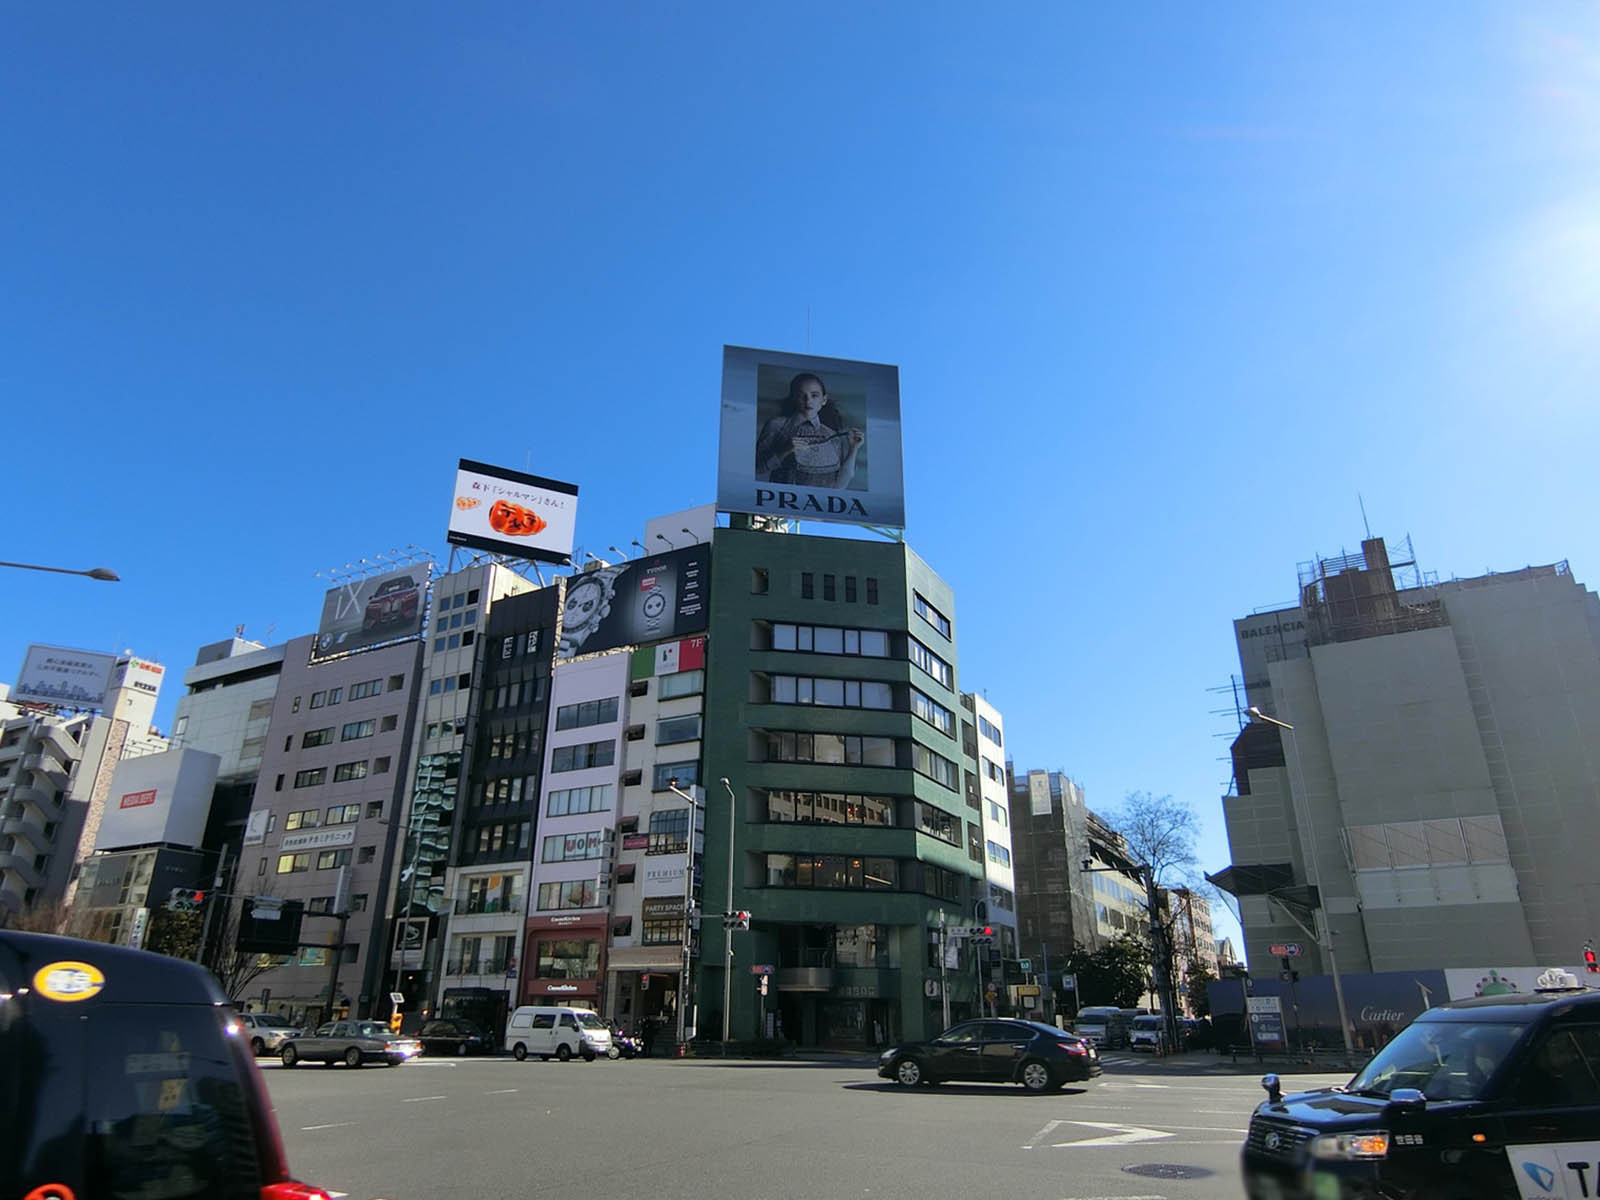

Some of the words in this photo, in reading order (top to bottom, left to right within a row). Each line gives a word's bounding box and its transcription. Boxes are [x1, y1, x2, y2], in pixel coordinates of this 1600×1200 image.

[755, 488, 868, 516] PRADA
[691, 639, 703, 648] 7F
[1361, 1005, 1404, 1022] Cartier
